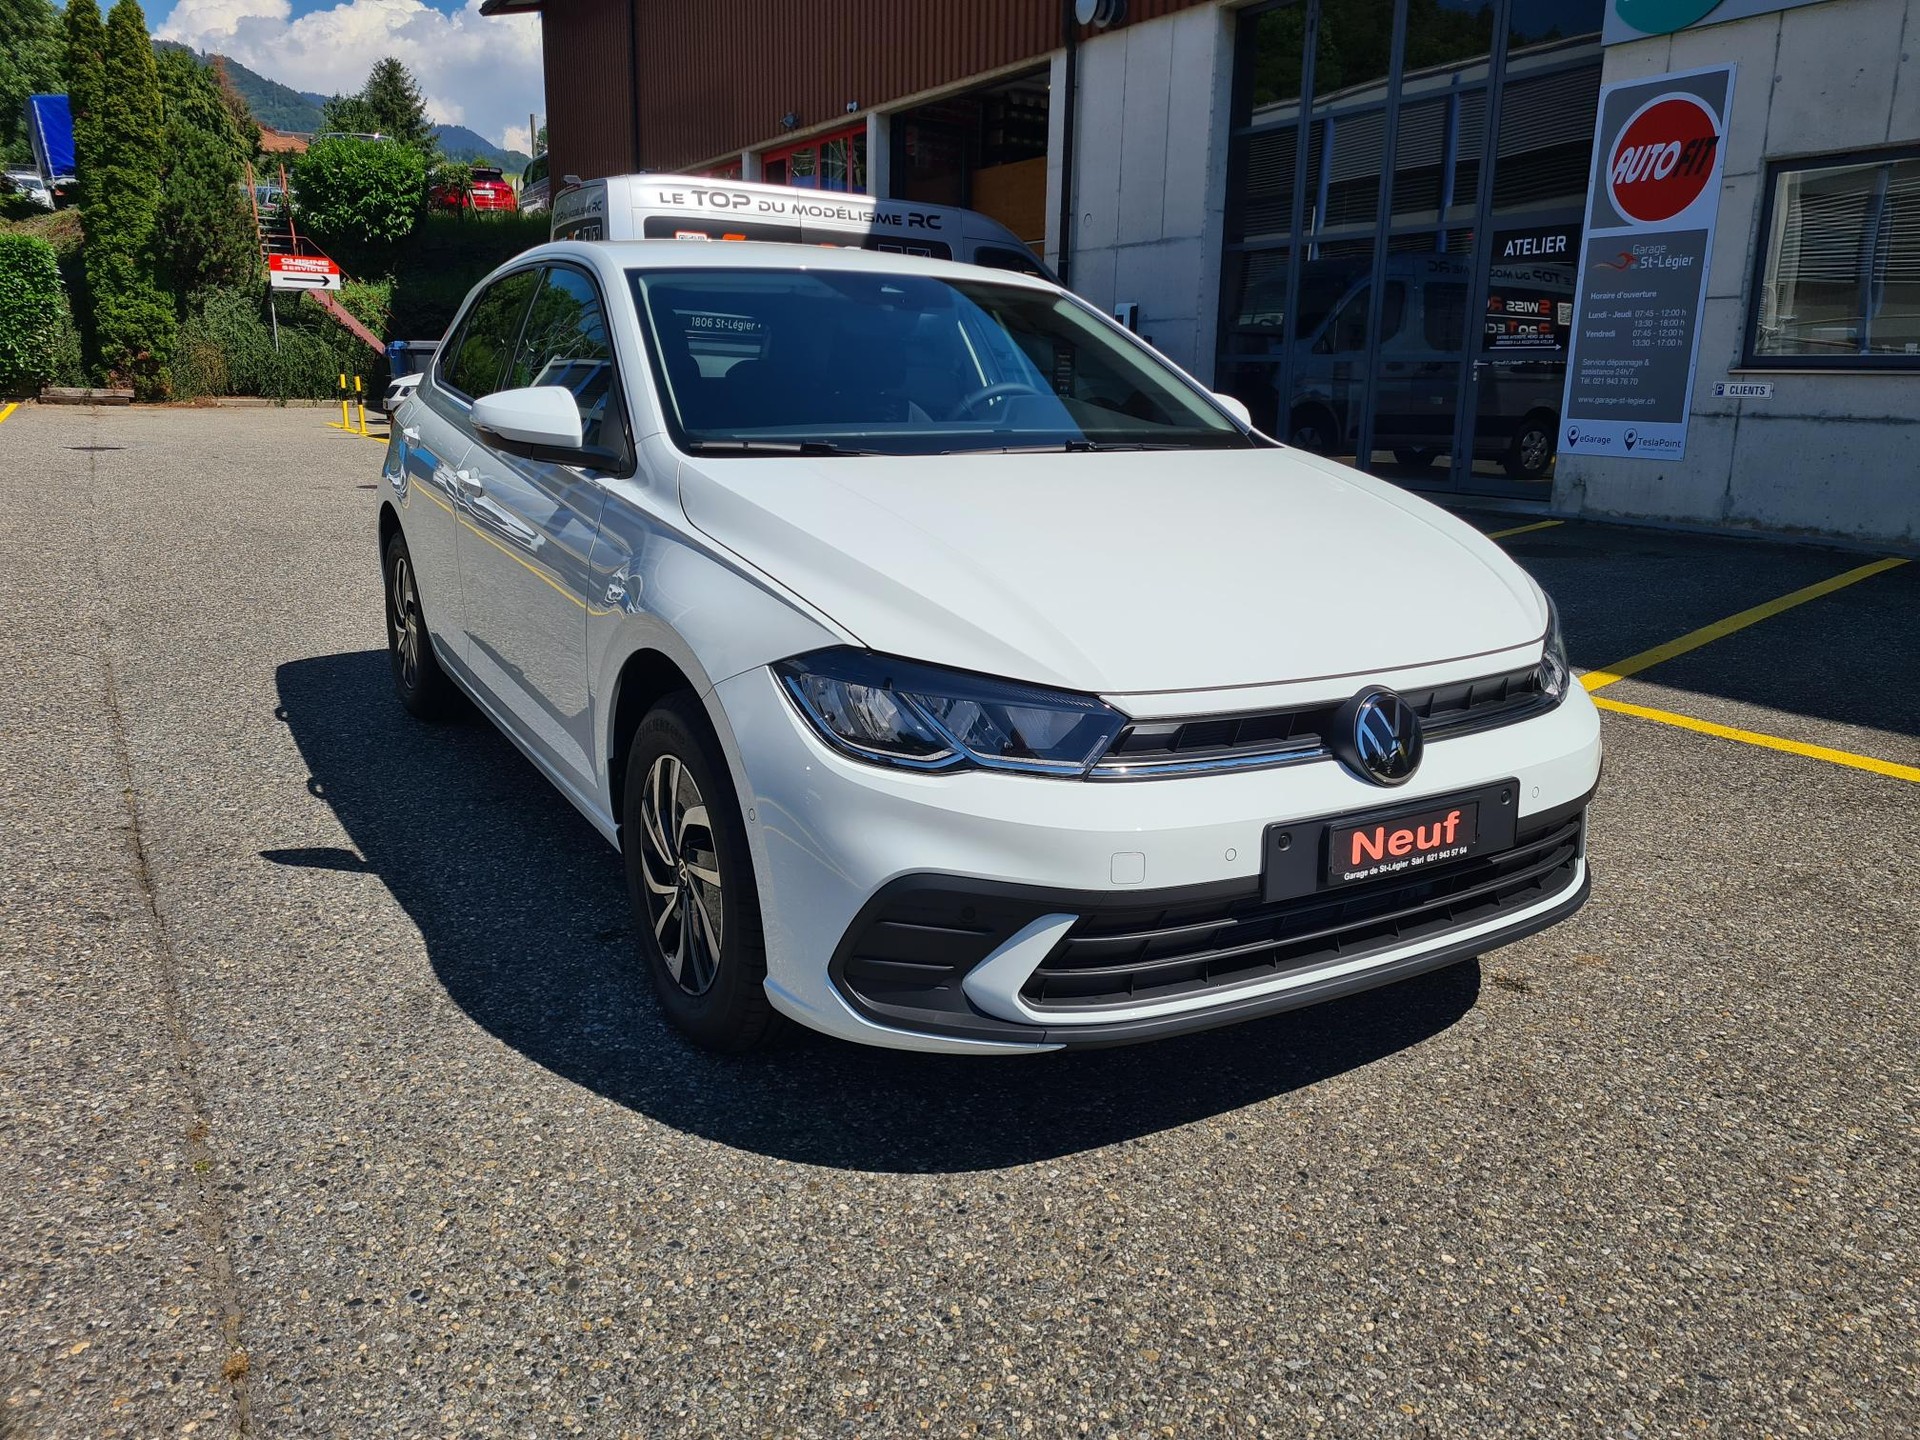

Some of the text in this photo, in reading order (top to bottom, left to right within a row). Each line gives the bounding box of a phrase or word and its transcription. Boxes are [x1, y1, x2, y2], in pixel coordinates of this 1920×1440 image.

[1612, 135, 1720, 185] AUTOFIT
[659, 190, 943, 231] LE TOP DU MODÉLISME RC
[1503, 235, 1567, 257] ATELIER
[1632, 244, 1667, 256] Garage
[281, 258, 329, 266] CUISINE
[1640, 254, 1694, 270] St-Légier
[282, 265, 330, 273] SERVICES
[1590, 290, 1657, 300] Horaire d'ouverture
[1634, 310, 1654, 318] 07:45
[1660, 309, 1680, 317] 12:00
[691, 317, 755, 331] 1806 St-Légier
[1585, 330, 1616, 338] Vendredi
[1606, 358, 1643, 367] dépannage
[1592, 377, 1604, 385] 021
[1729, 385, 1766, 396] CLIENTS
[1580, 434, 1611, 445] eGarage
[1637, 437, 1682, 449] TeslaPoint
[1352, 810, 1460, 865] Neuf
[1344, 870, 1368, 881] Garage
[1369, 867, 1378, 875] de
[1379, 860, 1408, 873] St-Légier
[1427, 853, 1438, 862] 021
[1439, 850, 1450, 860] 943
[1451, 848, 1459, 856] 57
[1460, 846, 1467, 854] 64
